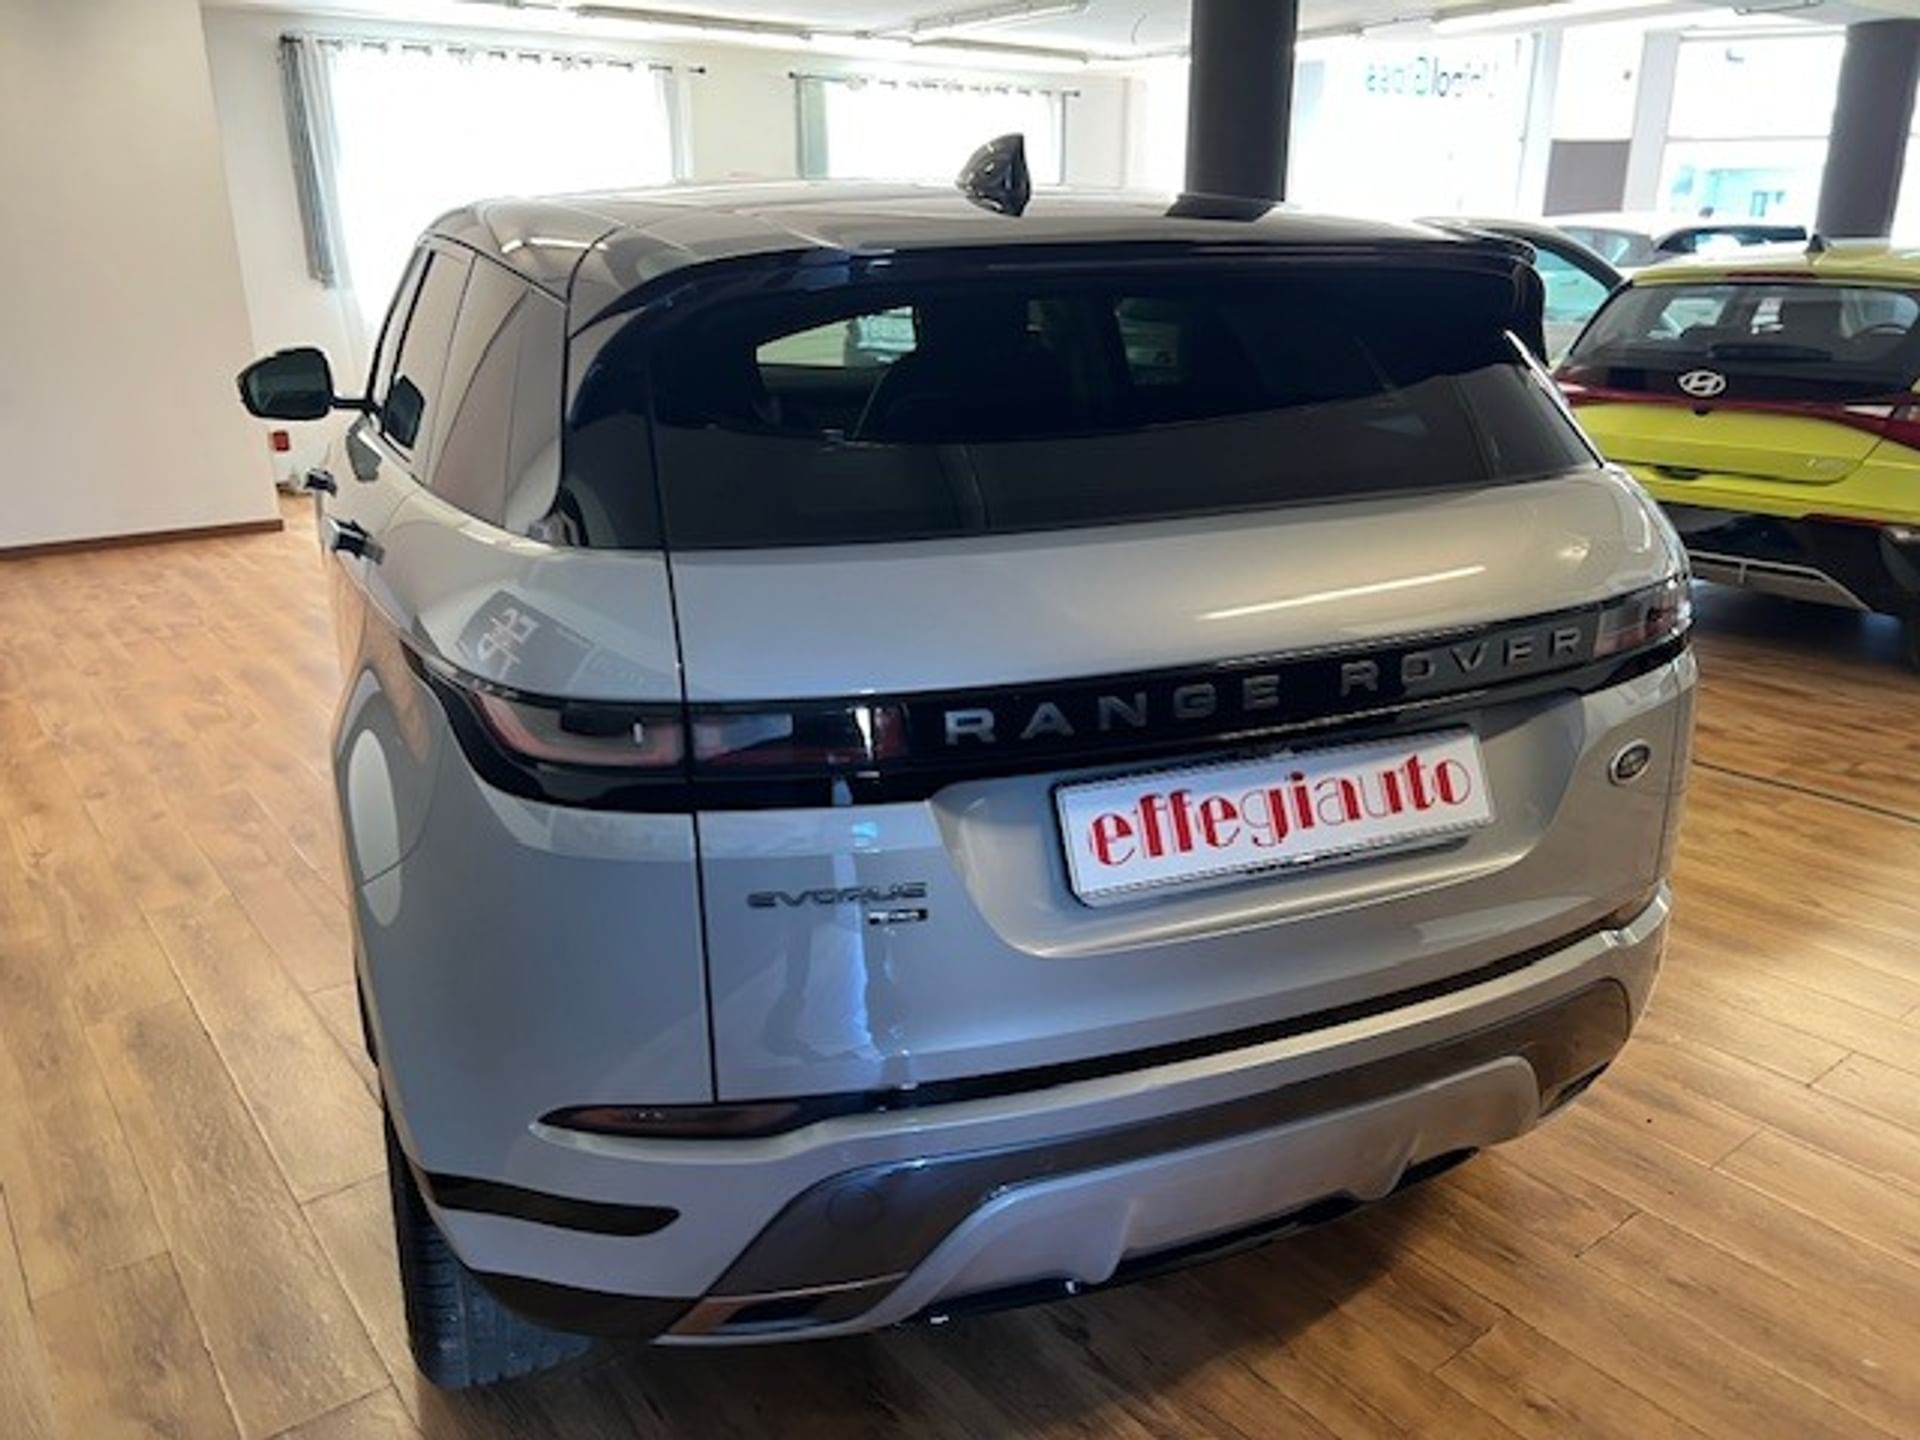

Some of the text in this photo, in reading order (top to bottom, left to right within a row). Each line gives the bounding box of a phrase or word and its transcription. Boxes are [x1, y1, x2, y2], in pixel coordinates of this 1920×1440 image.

[944, 625, 1582, 746] RANGE ROVER
[1088, 753, 1473, 867] effegiauto
